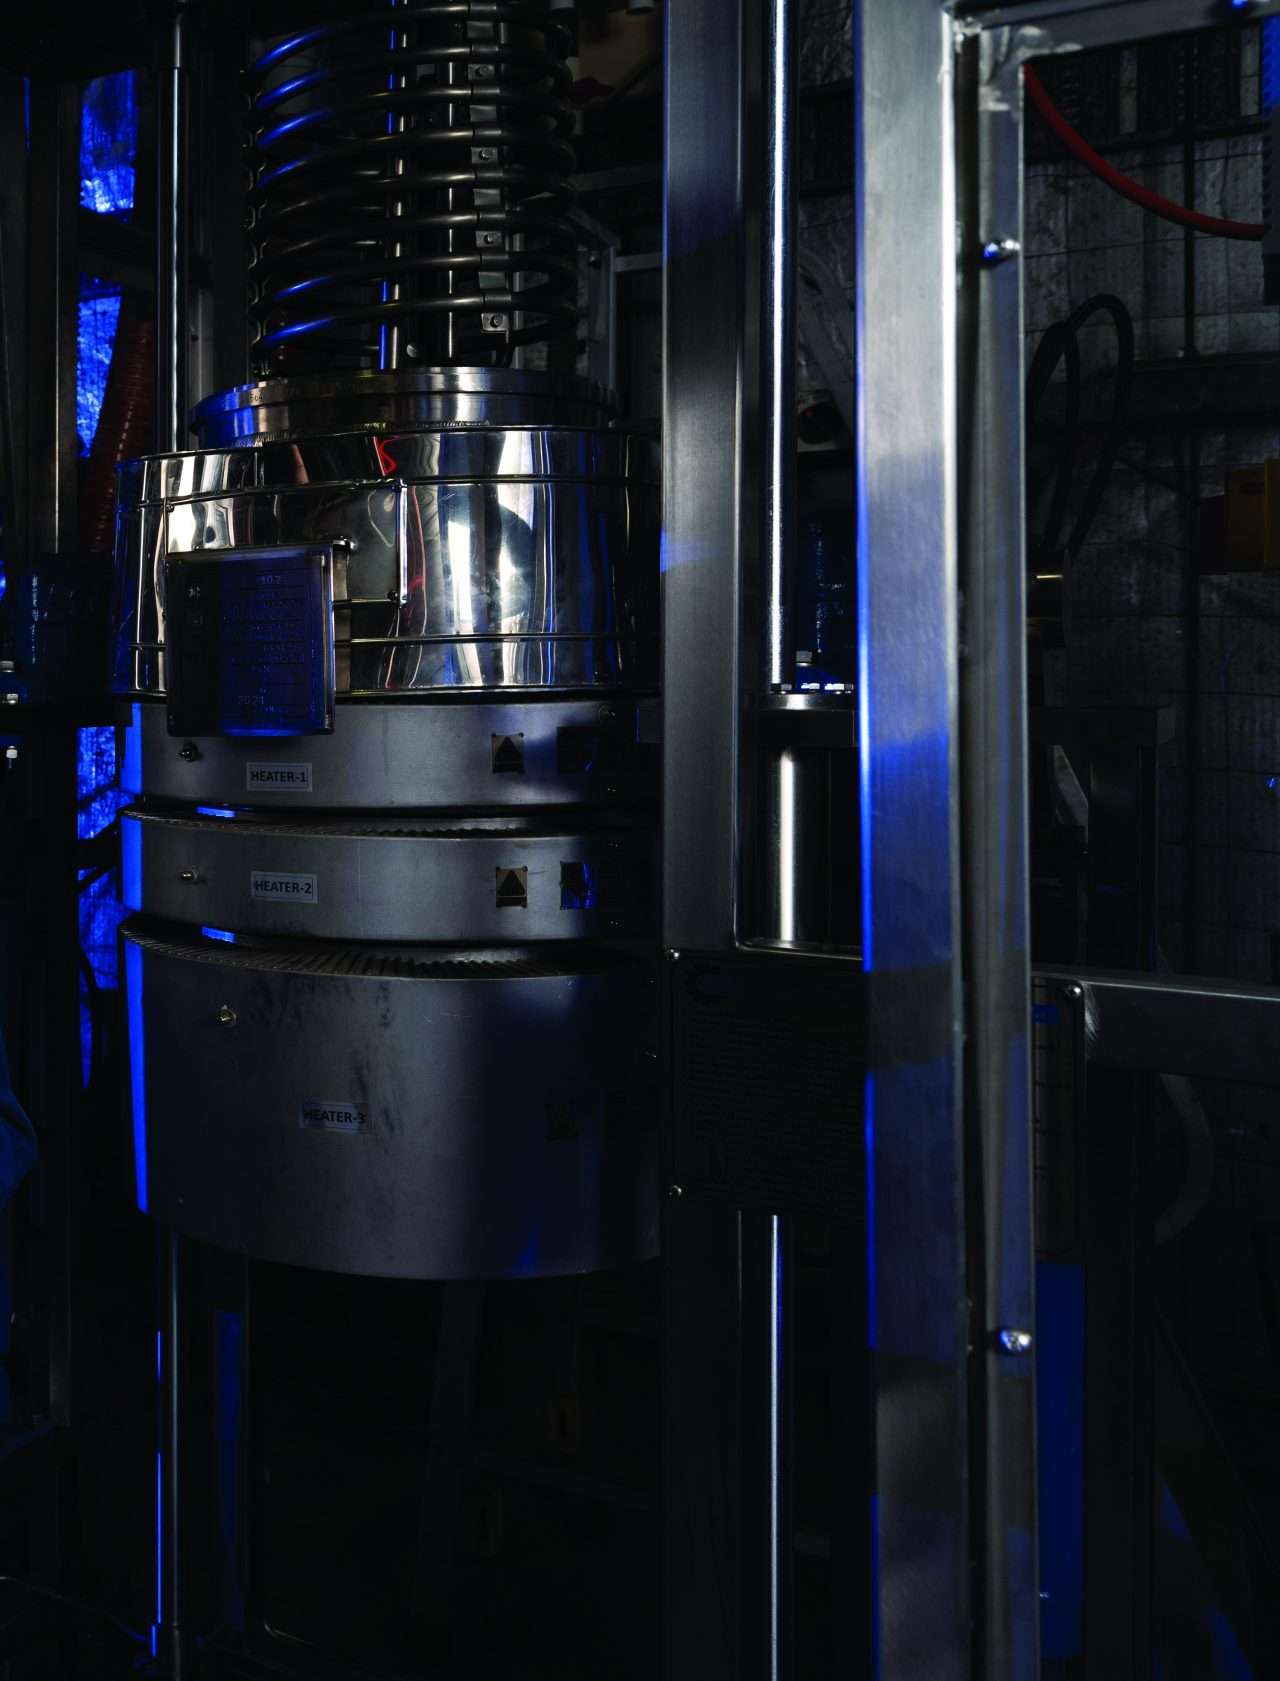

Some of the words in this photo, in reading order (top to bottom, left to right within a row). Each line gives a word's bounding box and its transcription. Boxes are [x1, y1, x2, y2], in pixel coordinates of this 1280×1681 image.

[251, 771, 307, 782] HEATER-1
[255, 880, 312, 895] HEATER-2
[303, 1109, 366, 1123] HEATER-3
